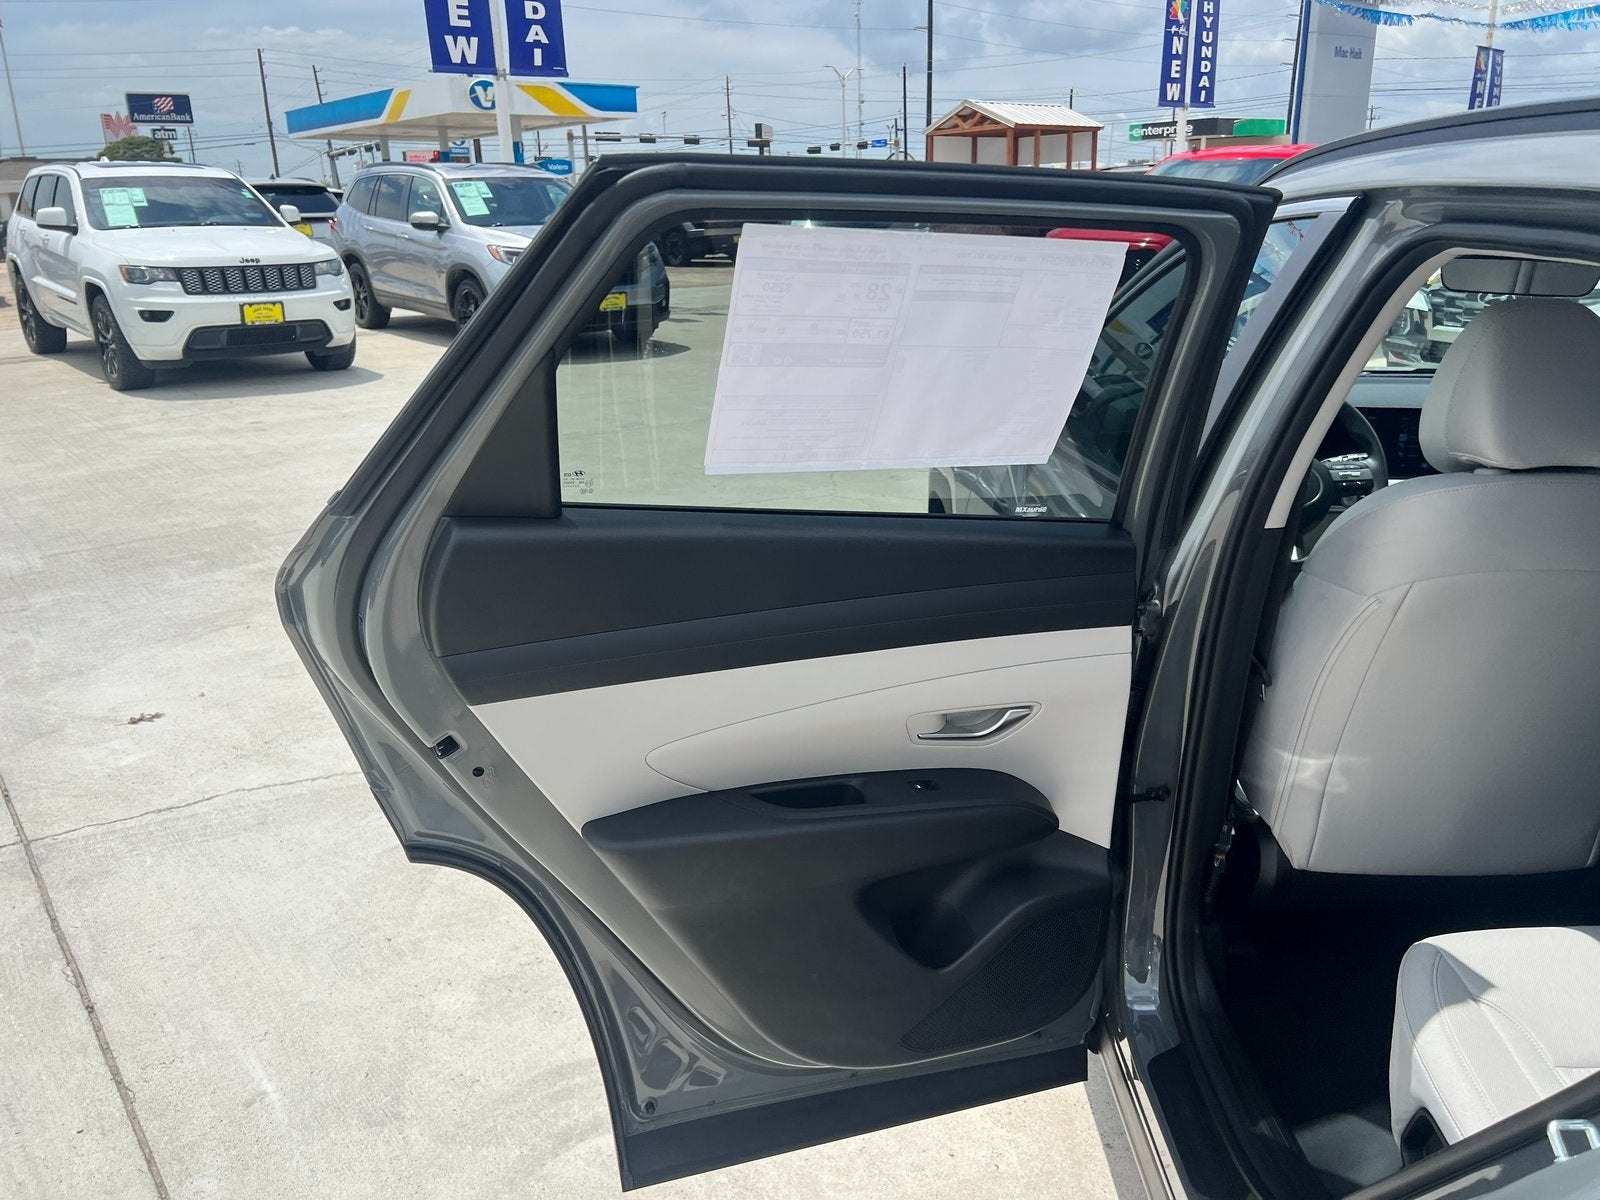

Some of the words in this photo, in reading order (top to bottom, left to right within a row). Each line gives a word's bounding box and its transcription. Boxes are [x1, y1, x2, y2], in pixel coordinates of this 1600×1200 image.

[1198, 1, 1214, 102] HYUNDAI
[1334, 46, 1348, 58] Mac
[1166, 36, 1184, 101] NEW
[133, 112, 191, 120] AmericanBank
[154, 130, 176, 139] atm
